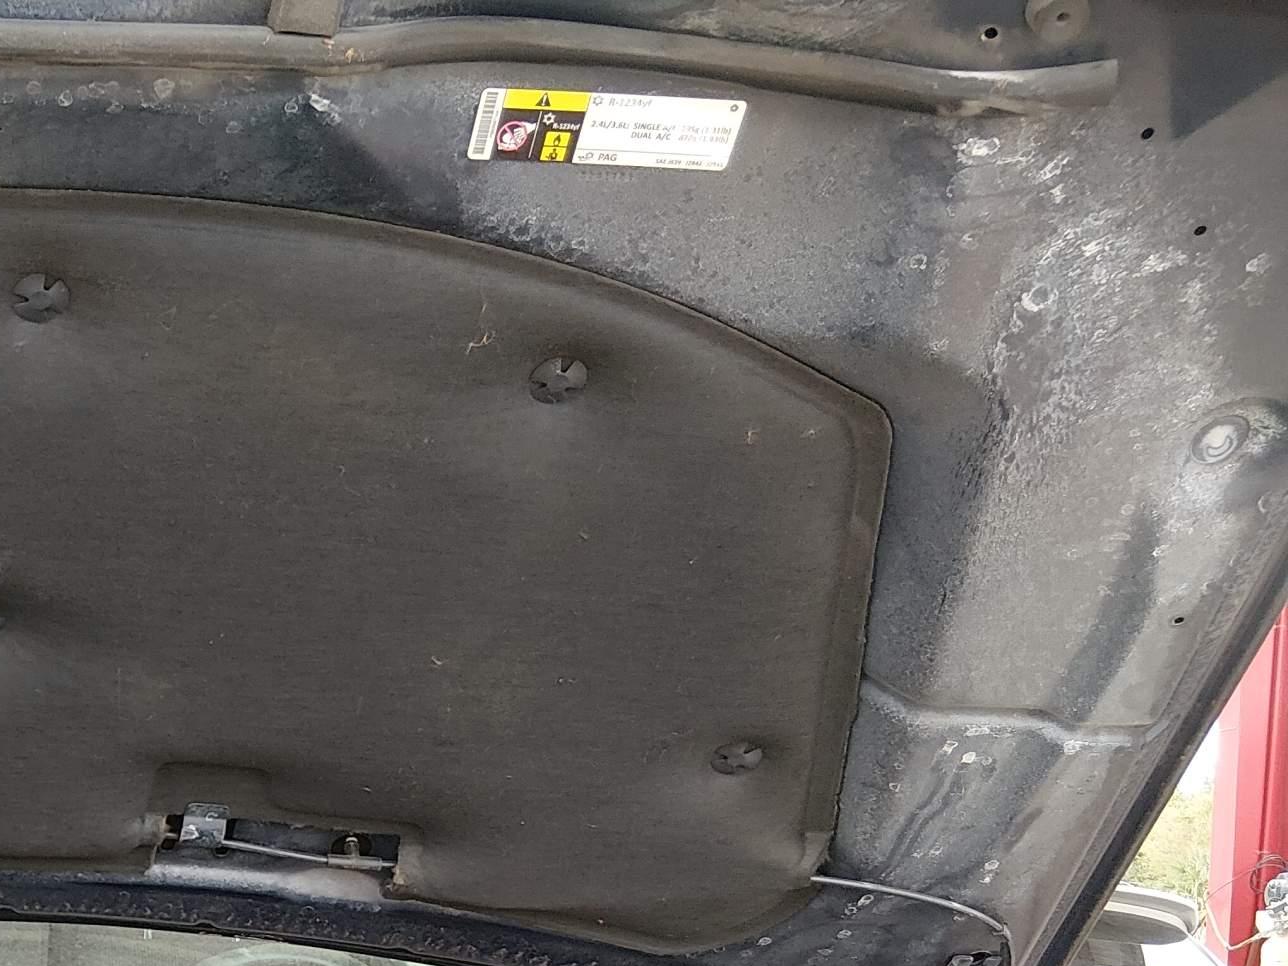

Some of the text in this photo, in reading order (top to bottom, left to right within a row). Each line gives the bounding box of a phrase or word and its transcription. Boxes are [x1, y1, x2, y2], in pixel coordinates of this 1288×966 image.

[632, 122, 661, 131] SINGLE
[630, 131, 652, 140] DUAL
[655, 132, 672, 141] A/C
[597, 153, 618, 162] PAG
